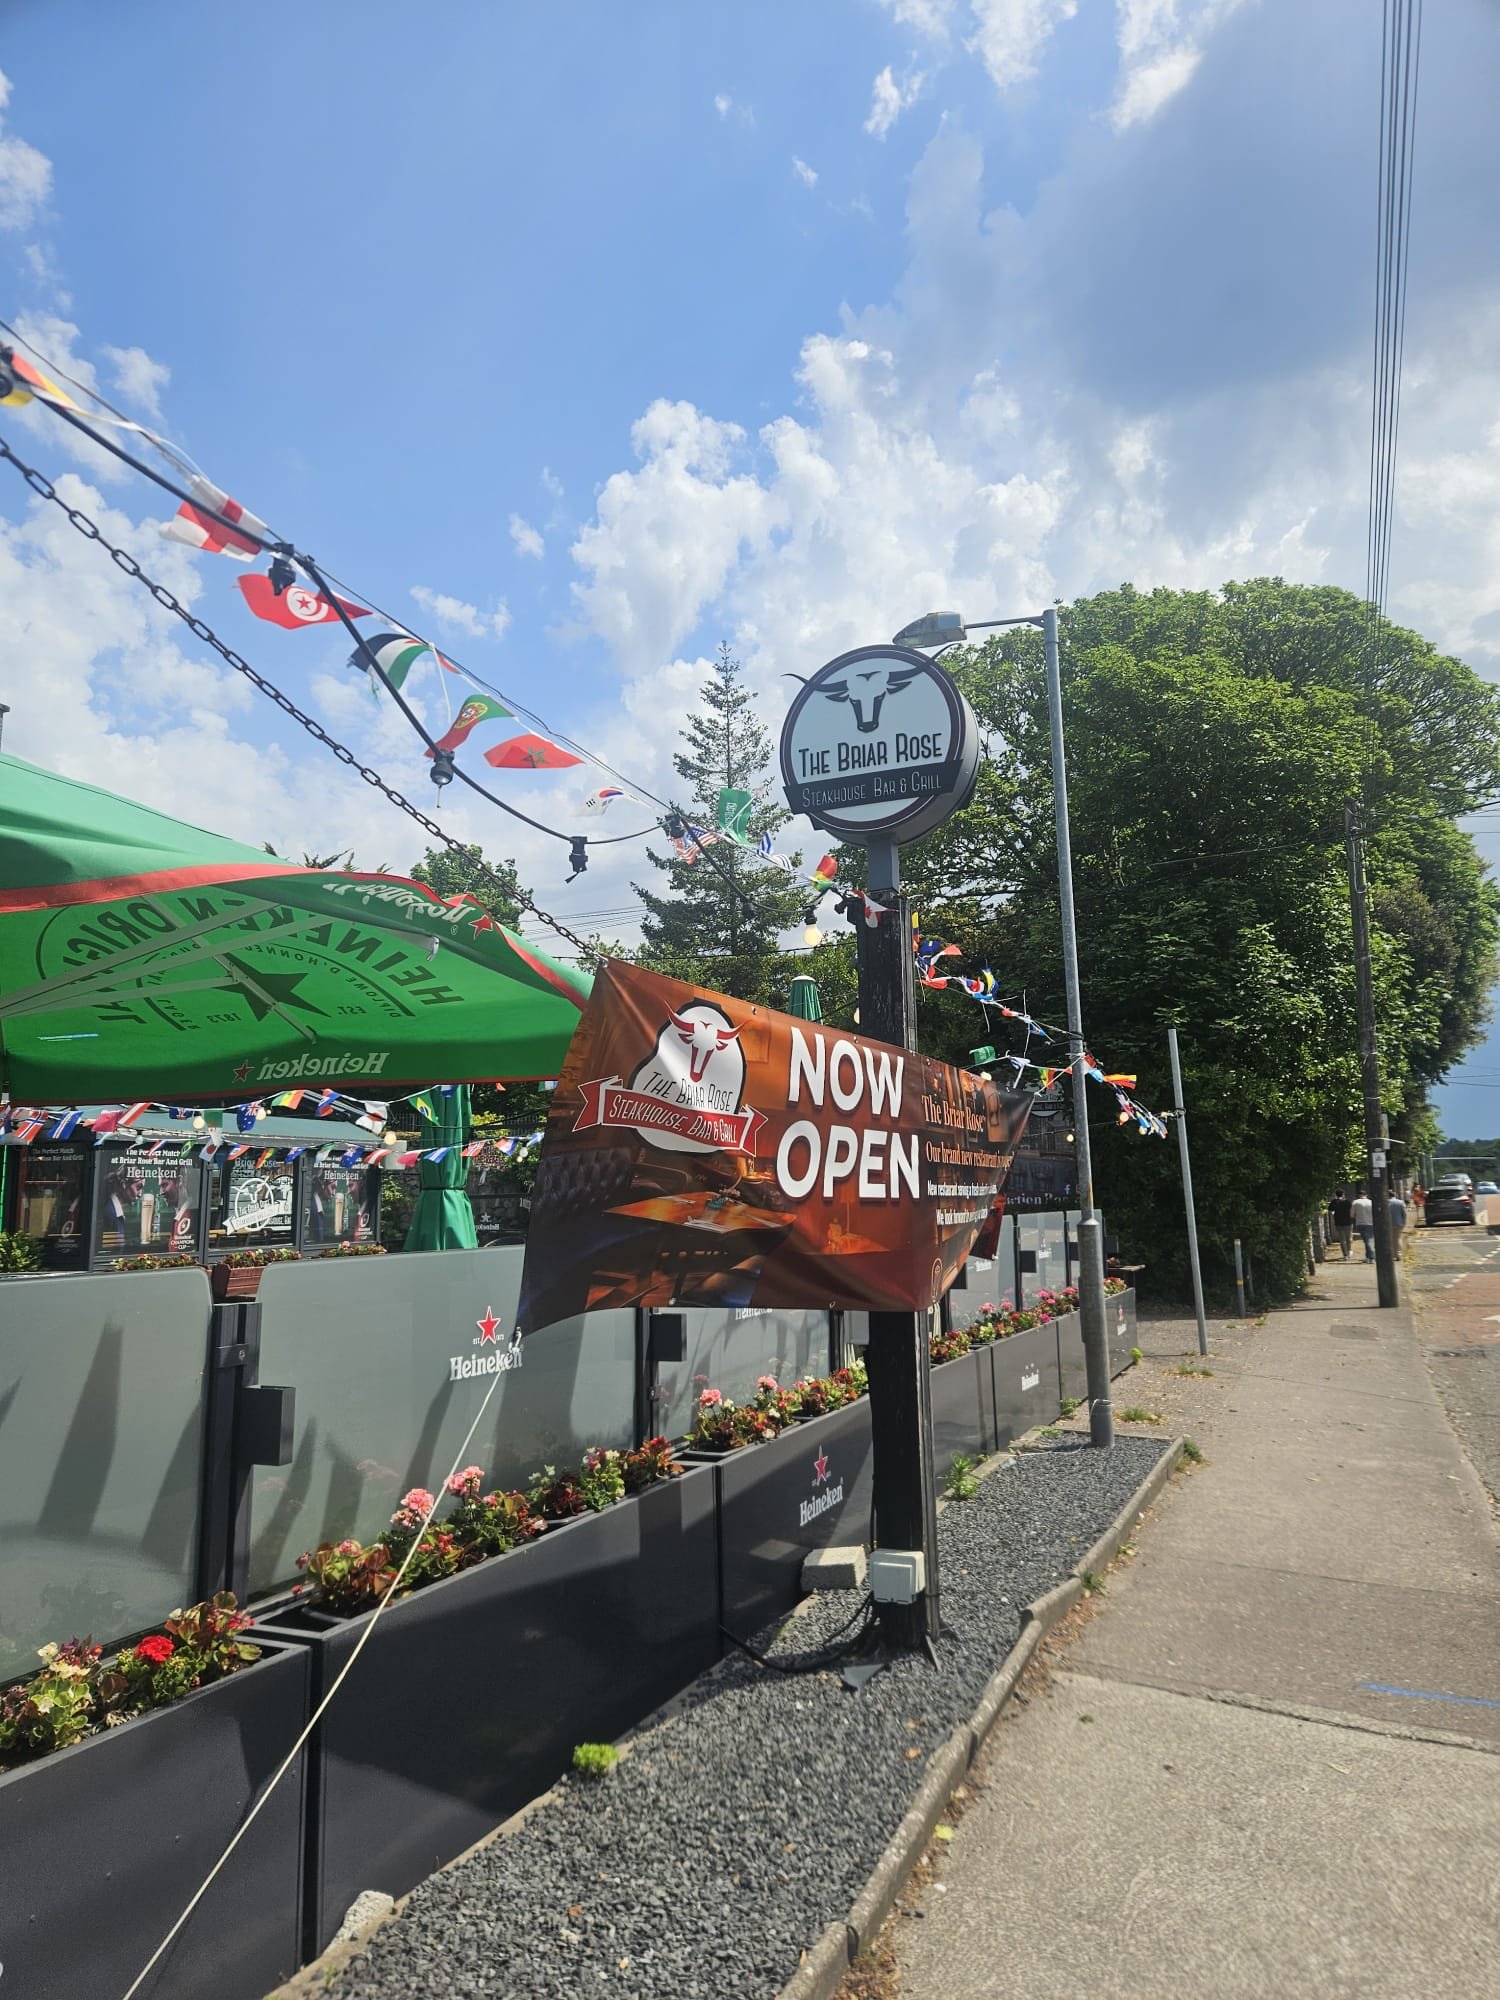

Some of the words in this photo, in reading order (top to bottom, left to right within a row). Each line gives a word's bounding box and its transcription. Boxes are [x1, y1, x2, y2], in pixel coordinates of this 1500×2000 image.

[798, 747, 831, 778] THE
[837, 740, 888, 772] BRIAR
[895, 732, 943, 763] ROSE
[802, 783, 867, 808] STEAKHOUSE
[874, 777, 896, 798] BAR
[899, 779, 907, 794] &
[911, 771, 942, 793] GRILL
[788, 1026, 904, 1118] NOW
[642, 1071, 677, 1099] THE
[675, 1077, 705, 1109] BRIAR
[707, 1083, 734, 1112] ROSE
[609, 1094, 688, 1132] STEAKHOUSE,
[688, 1115, 713, 1140] BAR
[713, 1122, 719, 1142] &
[719, 1118, 737, 1143] GRILL
[922, 1095, 943, 1124] The
[943, 1100, 965, 1129] Briar
[119, 1157, 136, 1165] Briar
[165, 1158, 178, 1166] And
[179, 1158, 193, 1166] Grill
[776, 1120, 920, 1199] OPEN
[926, 1140, 941, 1162] Our
[941, 1141, 960, 1164] brand
[961, 1149, 973, 1166] new
[973, 1149, 998, 1168] restaurant
[126, 1166, 177, 1178] Heineken
[324, 1170, 360, 1180] Heineken
[927, 1179, 937, 1196] New
[935, 1207, 944, 1226] We
[449, 1349, 523, 1381] Heineken
[800, 1484, 843, 1527] Heineken
